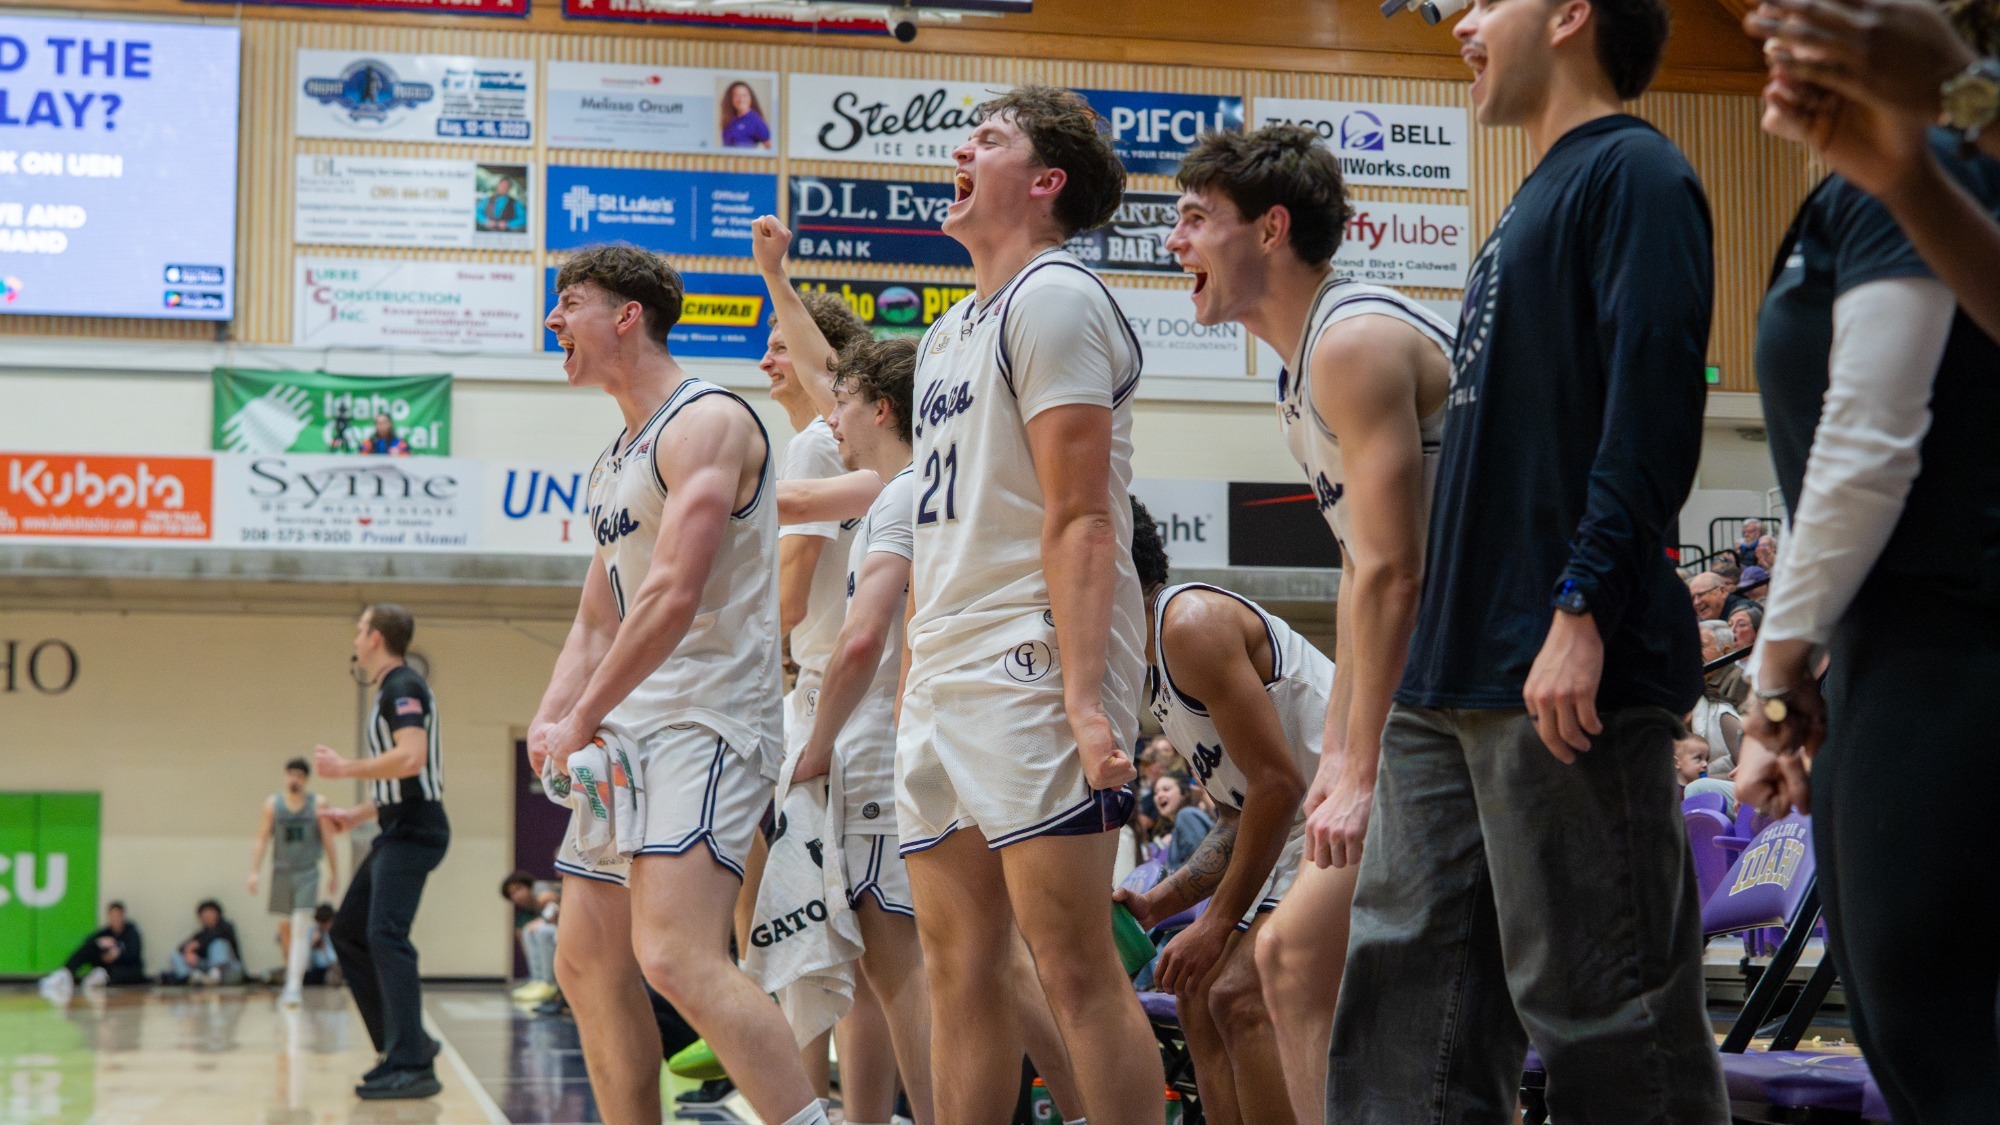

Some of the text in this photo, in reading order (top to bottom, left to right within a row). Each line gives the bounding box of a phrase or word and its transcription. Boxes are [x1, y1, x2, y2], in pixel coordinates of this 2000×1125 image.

[47, 38, 151, 78] THE
[875, 142, 903, 156] ICE
[1390, 124, 1451, 146] BELL
[21, 151, 63, 176] ON
[26, 204, 87, 229] AND
[799, 180, 878, 219] D.L.
[1393, 213, 1458, 246] lube
[799, 238, 871, 258] BANK
[1369, 259, 1395, 269] Blvd
[1405, 260, 1457, 271] Caldwell
[9, 458, 186, 509] Kubota
[249, 458, 458, 509] Syme
[503, 469, 588, 520] UN
[916, 441, 957, 527] 21
[1728, 838, 1805, 897] IDAHO
